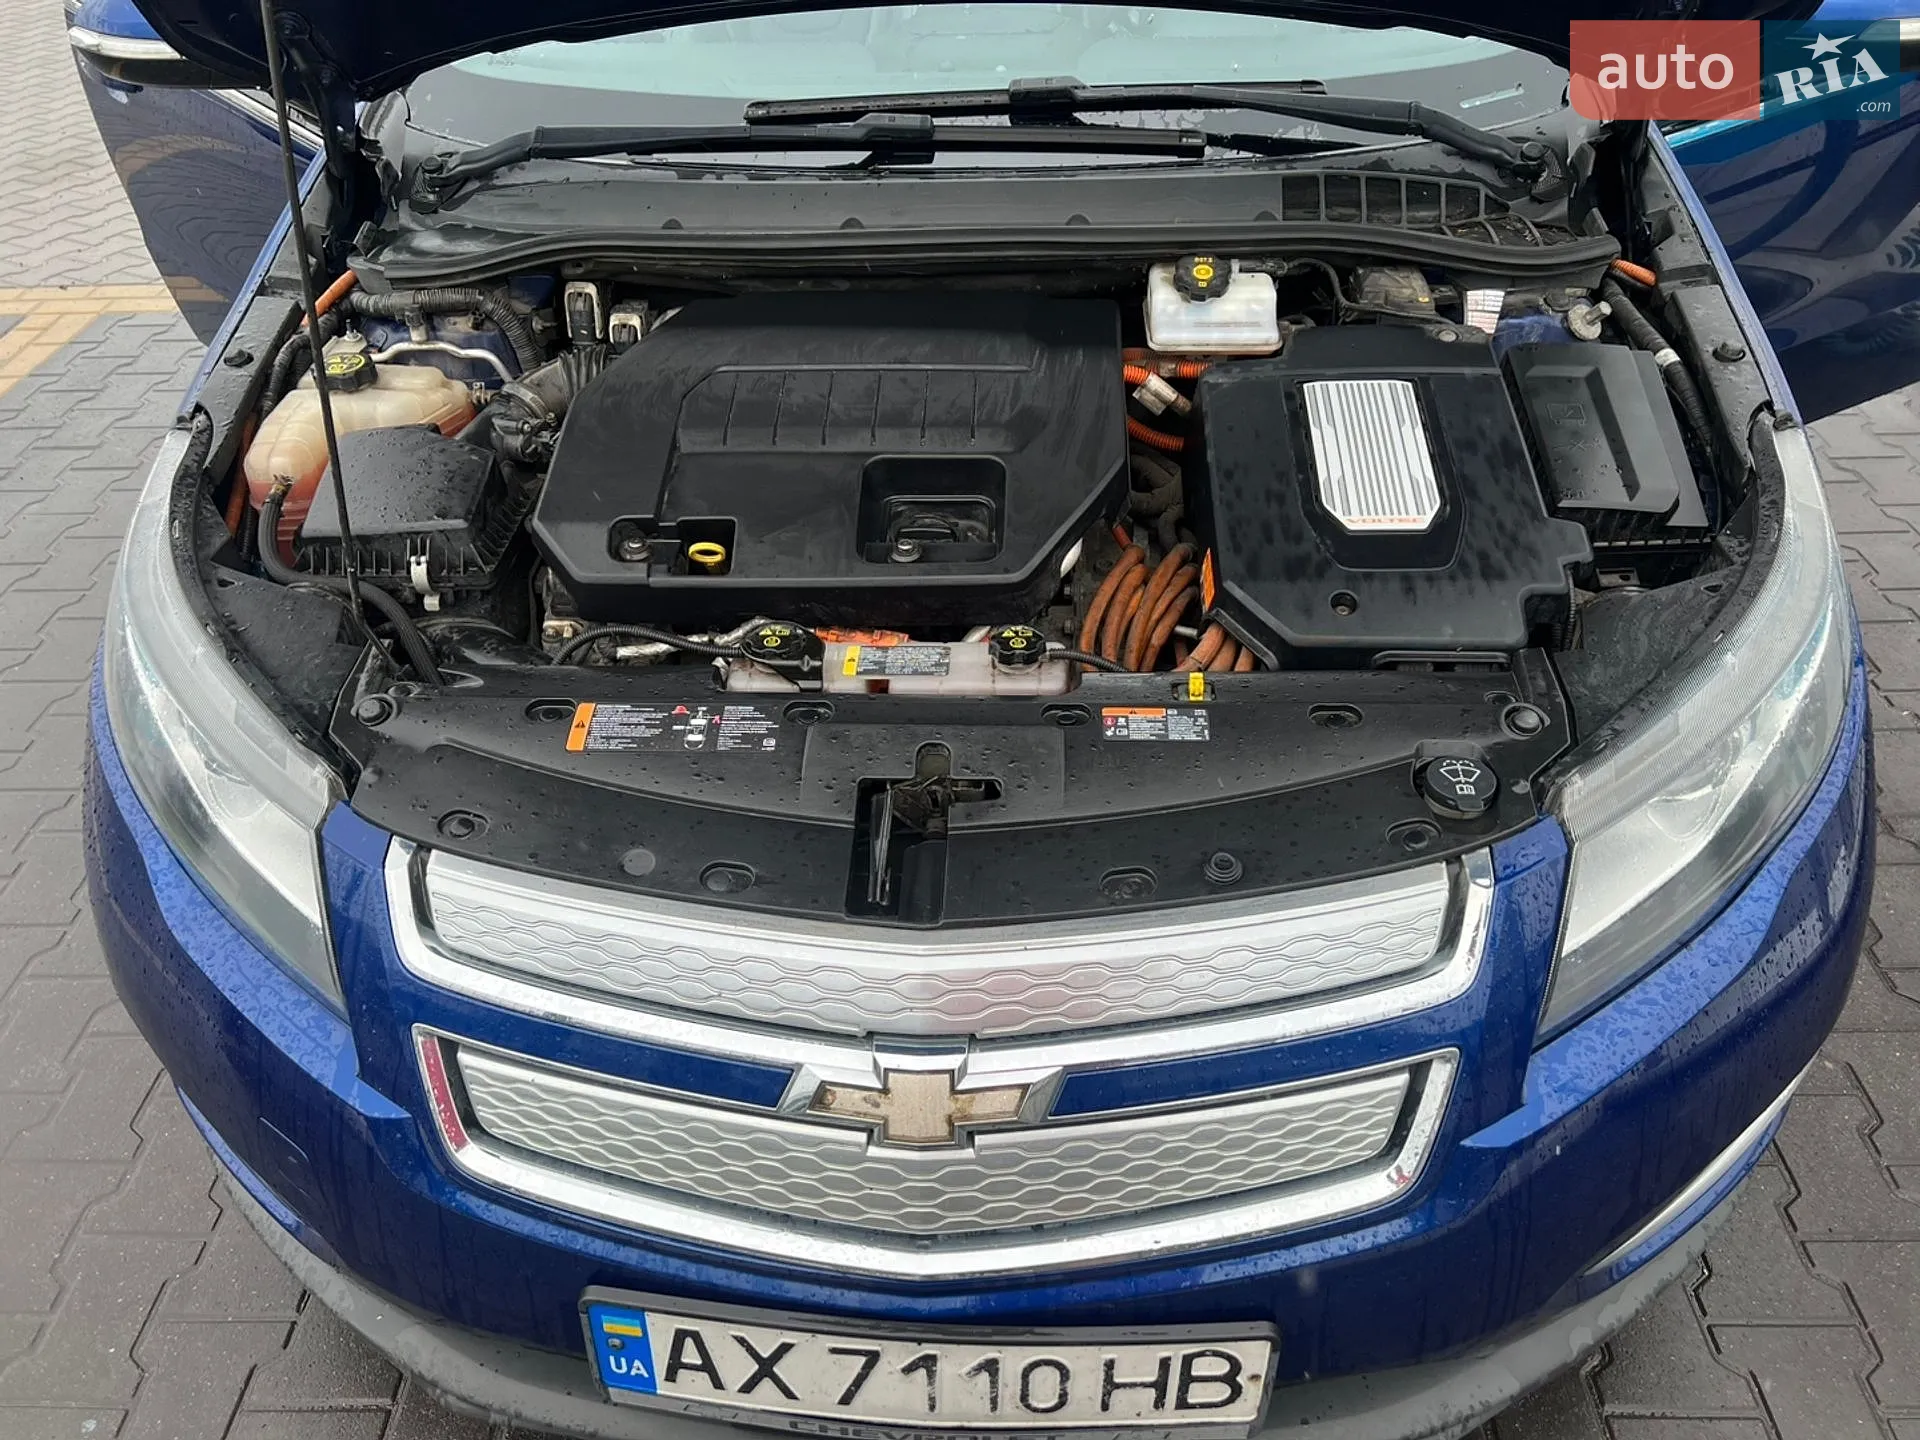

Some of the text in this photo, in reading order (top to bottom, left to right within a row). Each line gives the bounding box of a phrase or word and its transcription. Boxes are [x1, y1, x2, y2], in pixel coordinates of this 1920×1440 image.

[609, 1355, 649, 1378] UA
[664, 1327, 1243, 1414] AX 7110 HB
